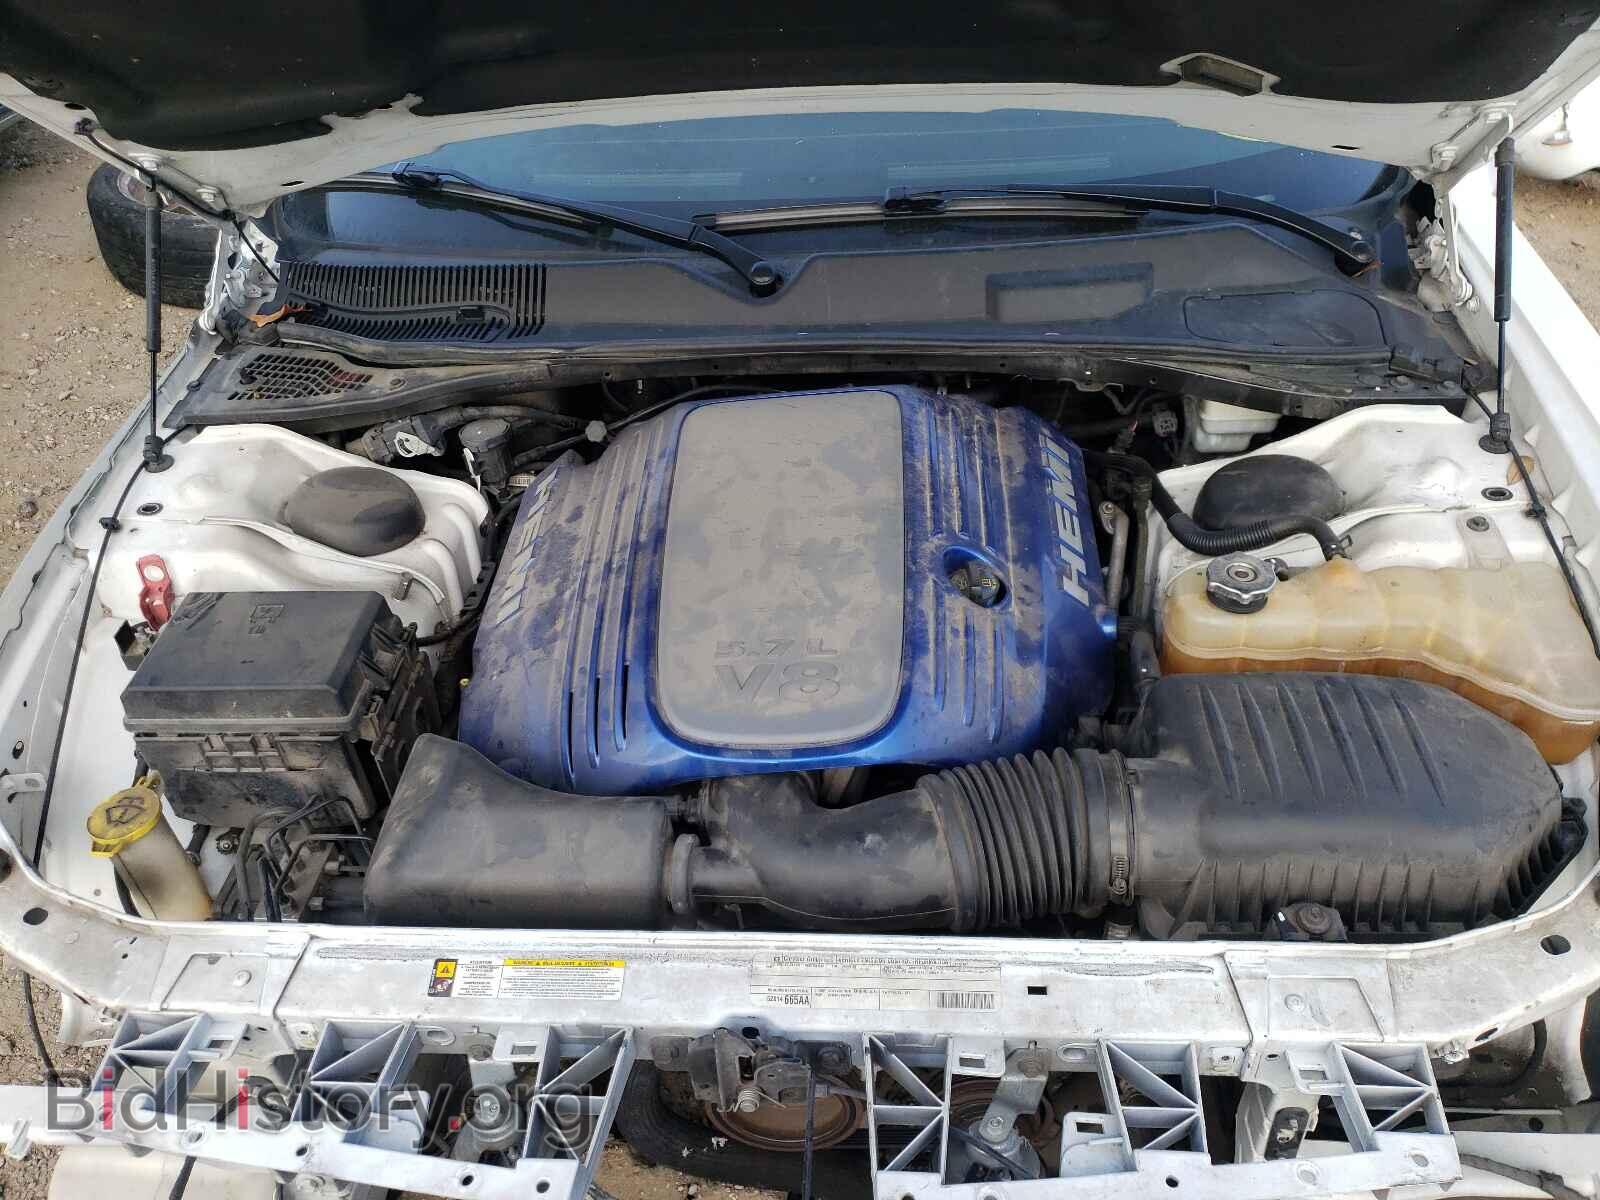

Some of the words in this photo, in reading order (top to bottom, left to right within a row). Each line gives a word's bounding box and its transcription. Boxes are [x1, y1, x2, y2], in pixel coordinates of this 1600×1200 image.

[1038, 431, 1090, 607] HEMI
[713, 661, 841, 705] V8
[784, 994, 810, 1005] 665AA
